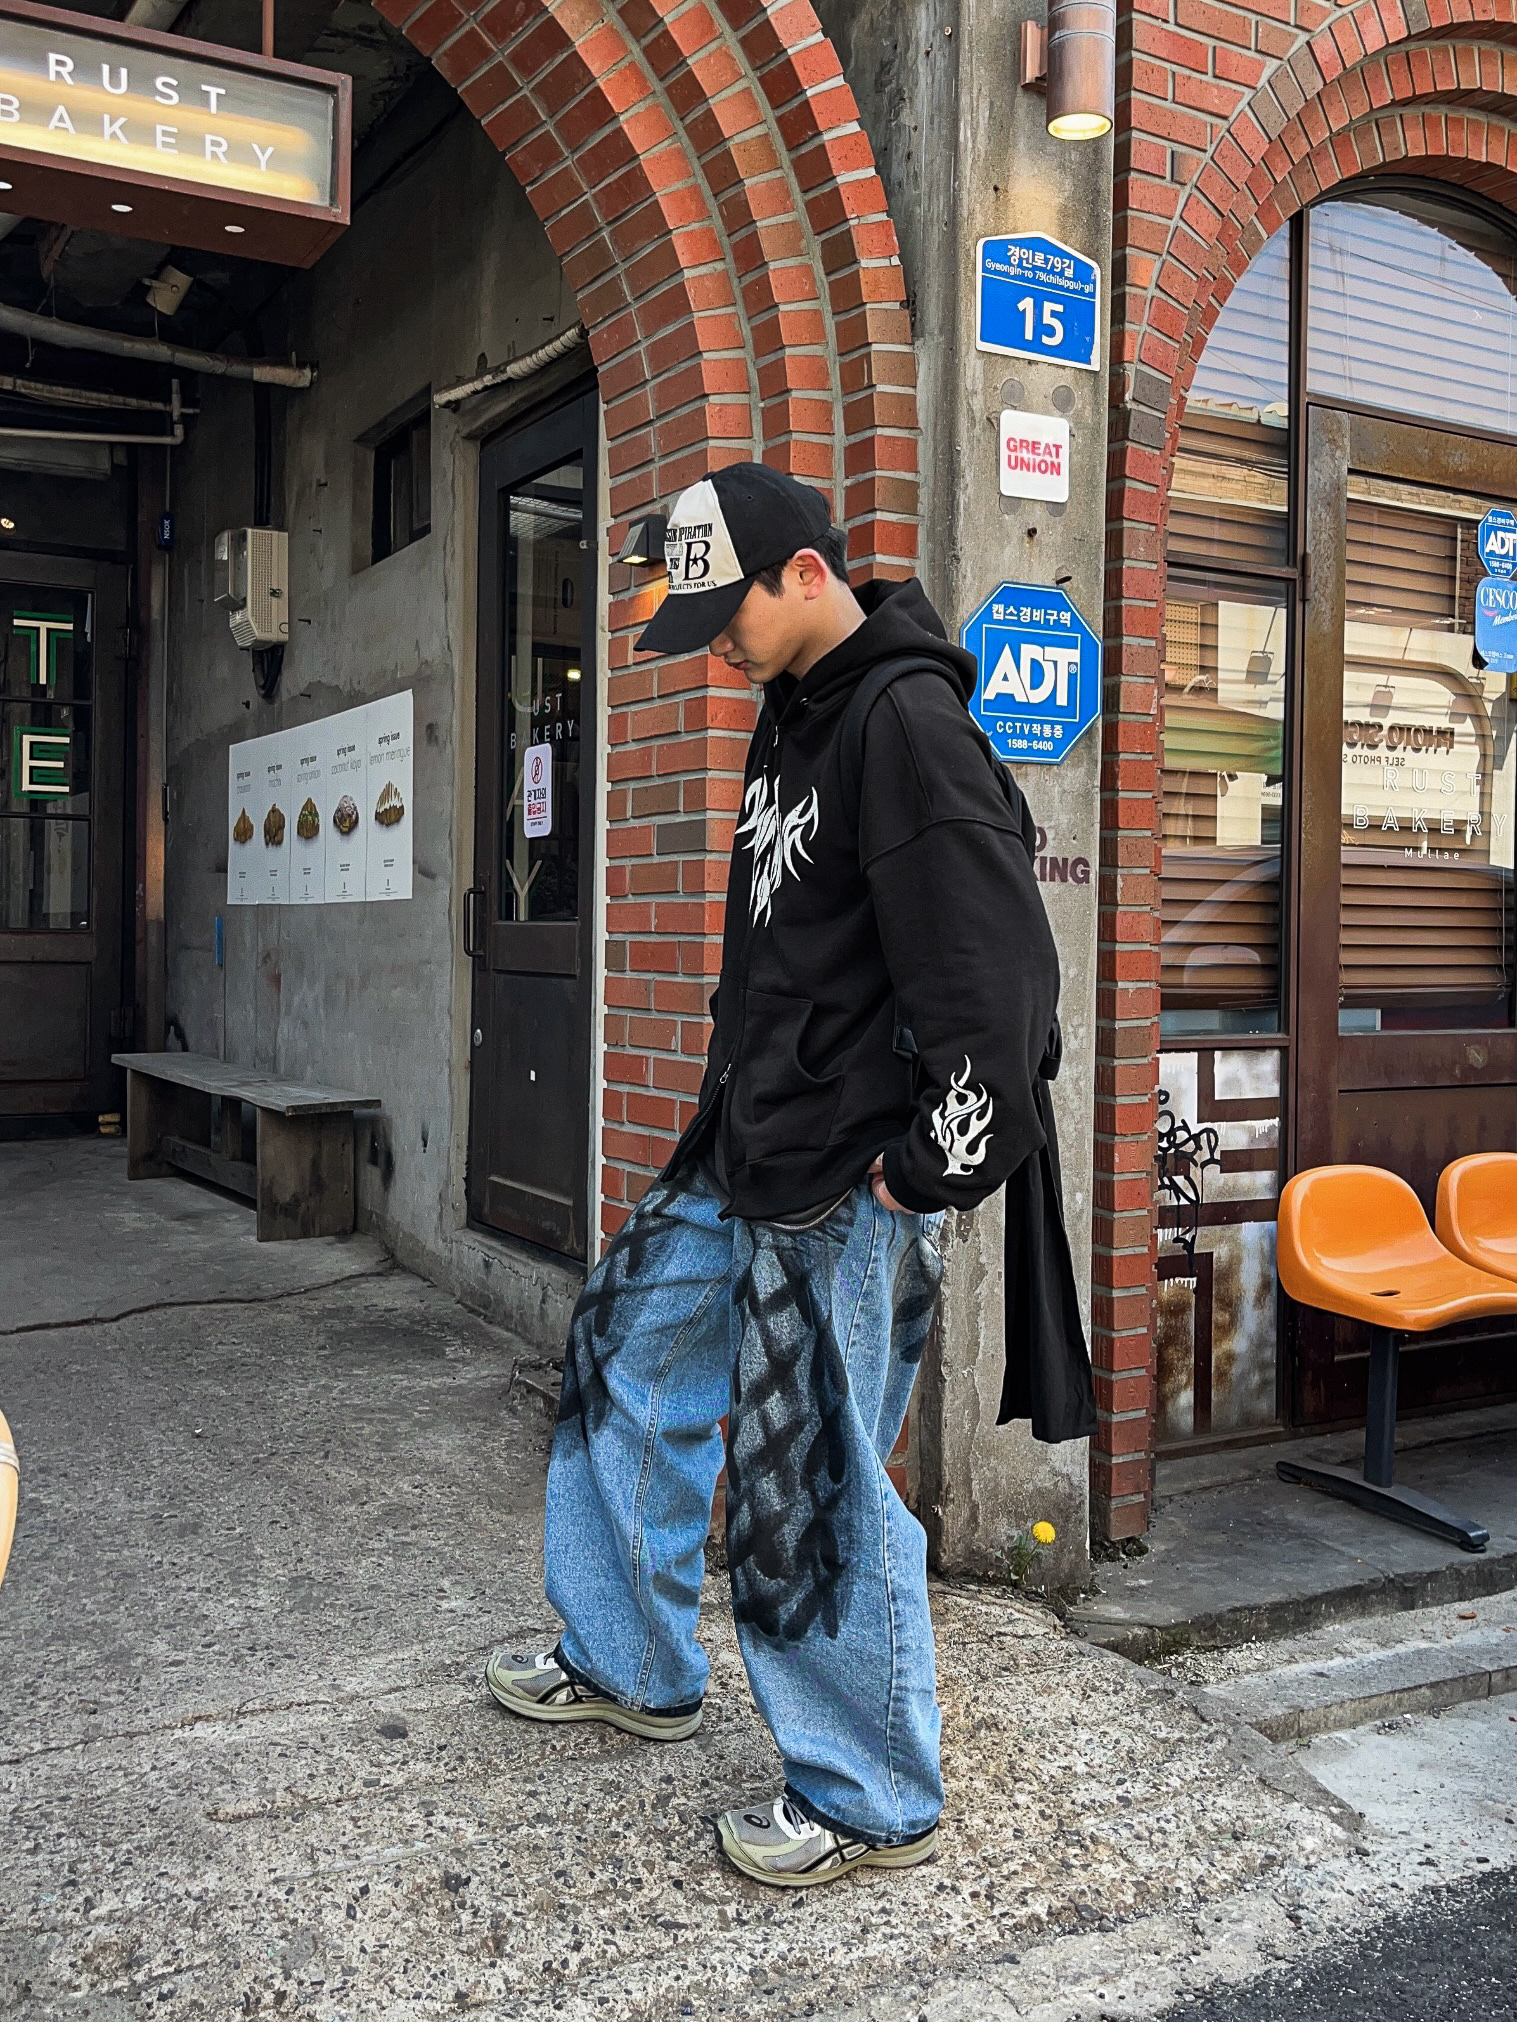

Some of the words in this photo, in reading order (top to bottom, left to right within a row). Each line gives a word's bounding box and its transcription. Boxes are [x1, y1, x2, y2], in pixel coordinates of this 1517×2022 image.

[48, 52, 226, 115] RUST
[0, 93, 275, 172] BAKERY
[985, 258, 1034, 280] Gyeongin-ro
[1006, 244, 1075, 279] 경인로79길
[1016, 296, 1065, 346] 15
[1005, 436, 1063, 460] GREAT
[1006, 454, 1062, 477] UNION
[1485, 530, 1517, 557] ADT
[991, 603, 1072, 628] 캡스경비구역
[982, 642, 1079, 707] ADT
[996, 720, 1064, 739] CCTV작동중
[1006, 738, 1054, 751] 1588-6400
[1382, 766, 1482, 797] RUST
[1353, 804, 1508, 837] BAKERY
[1404, 847, 1460, 861] Mullae
